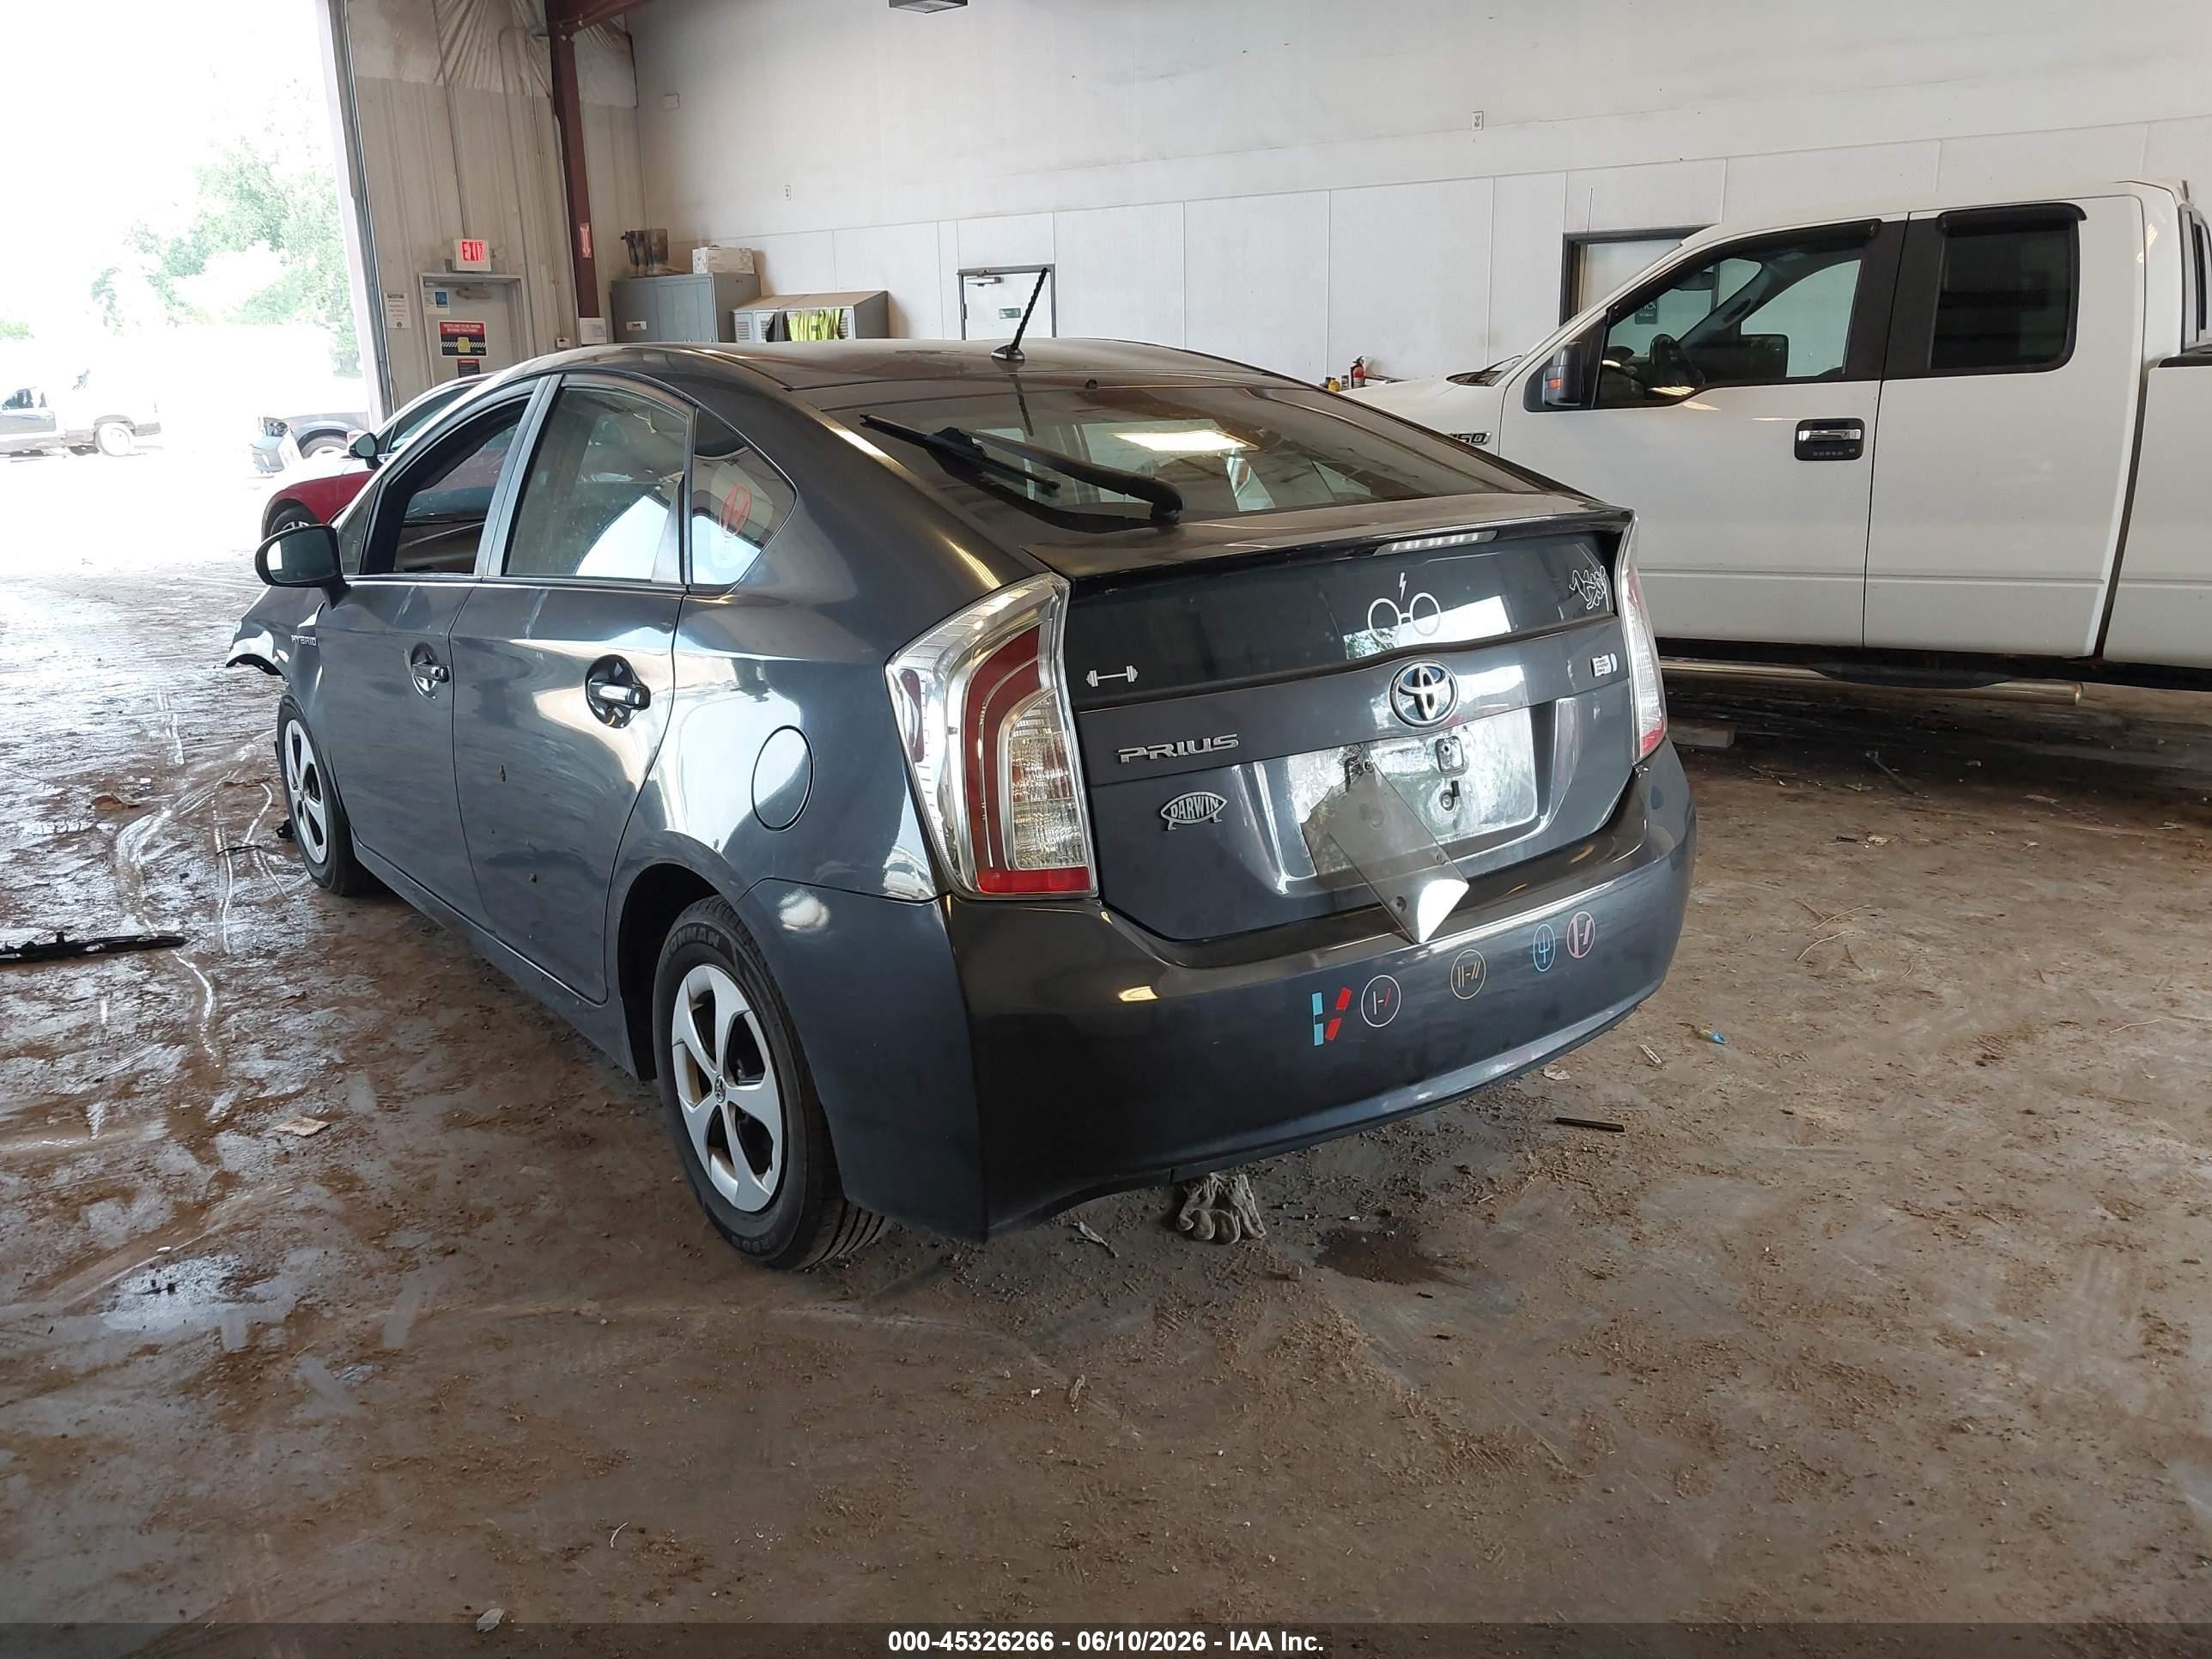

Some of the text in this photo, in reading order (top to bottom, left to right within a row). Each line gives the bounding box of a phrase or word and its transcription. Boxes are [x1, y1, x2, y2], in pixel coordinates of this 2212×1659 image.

[461, 241, 485, 261] EXIT
[291, 635, 317, 646] HYBRID
[1117, 733, 1239, 763] PRIUS
[1170, 795, 1220, 821] DARWIN
